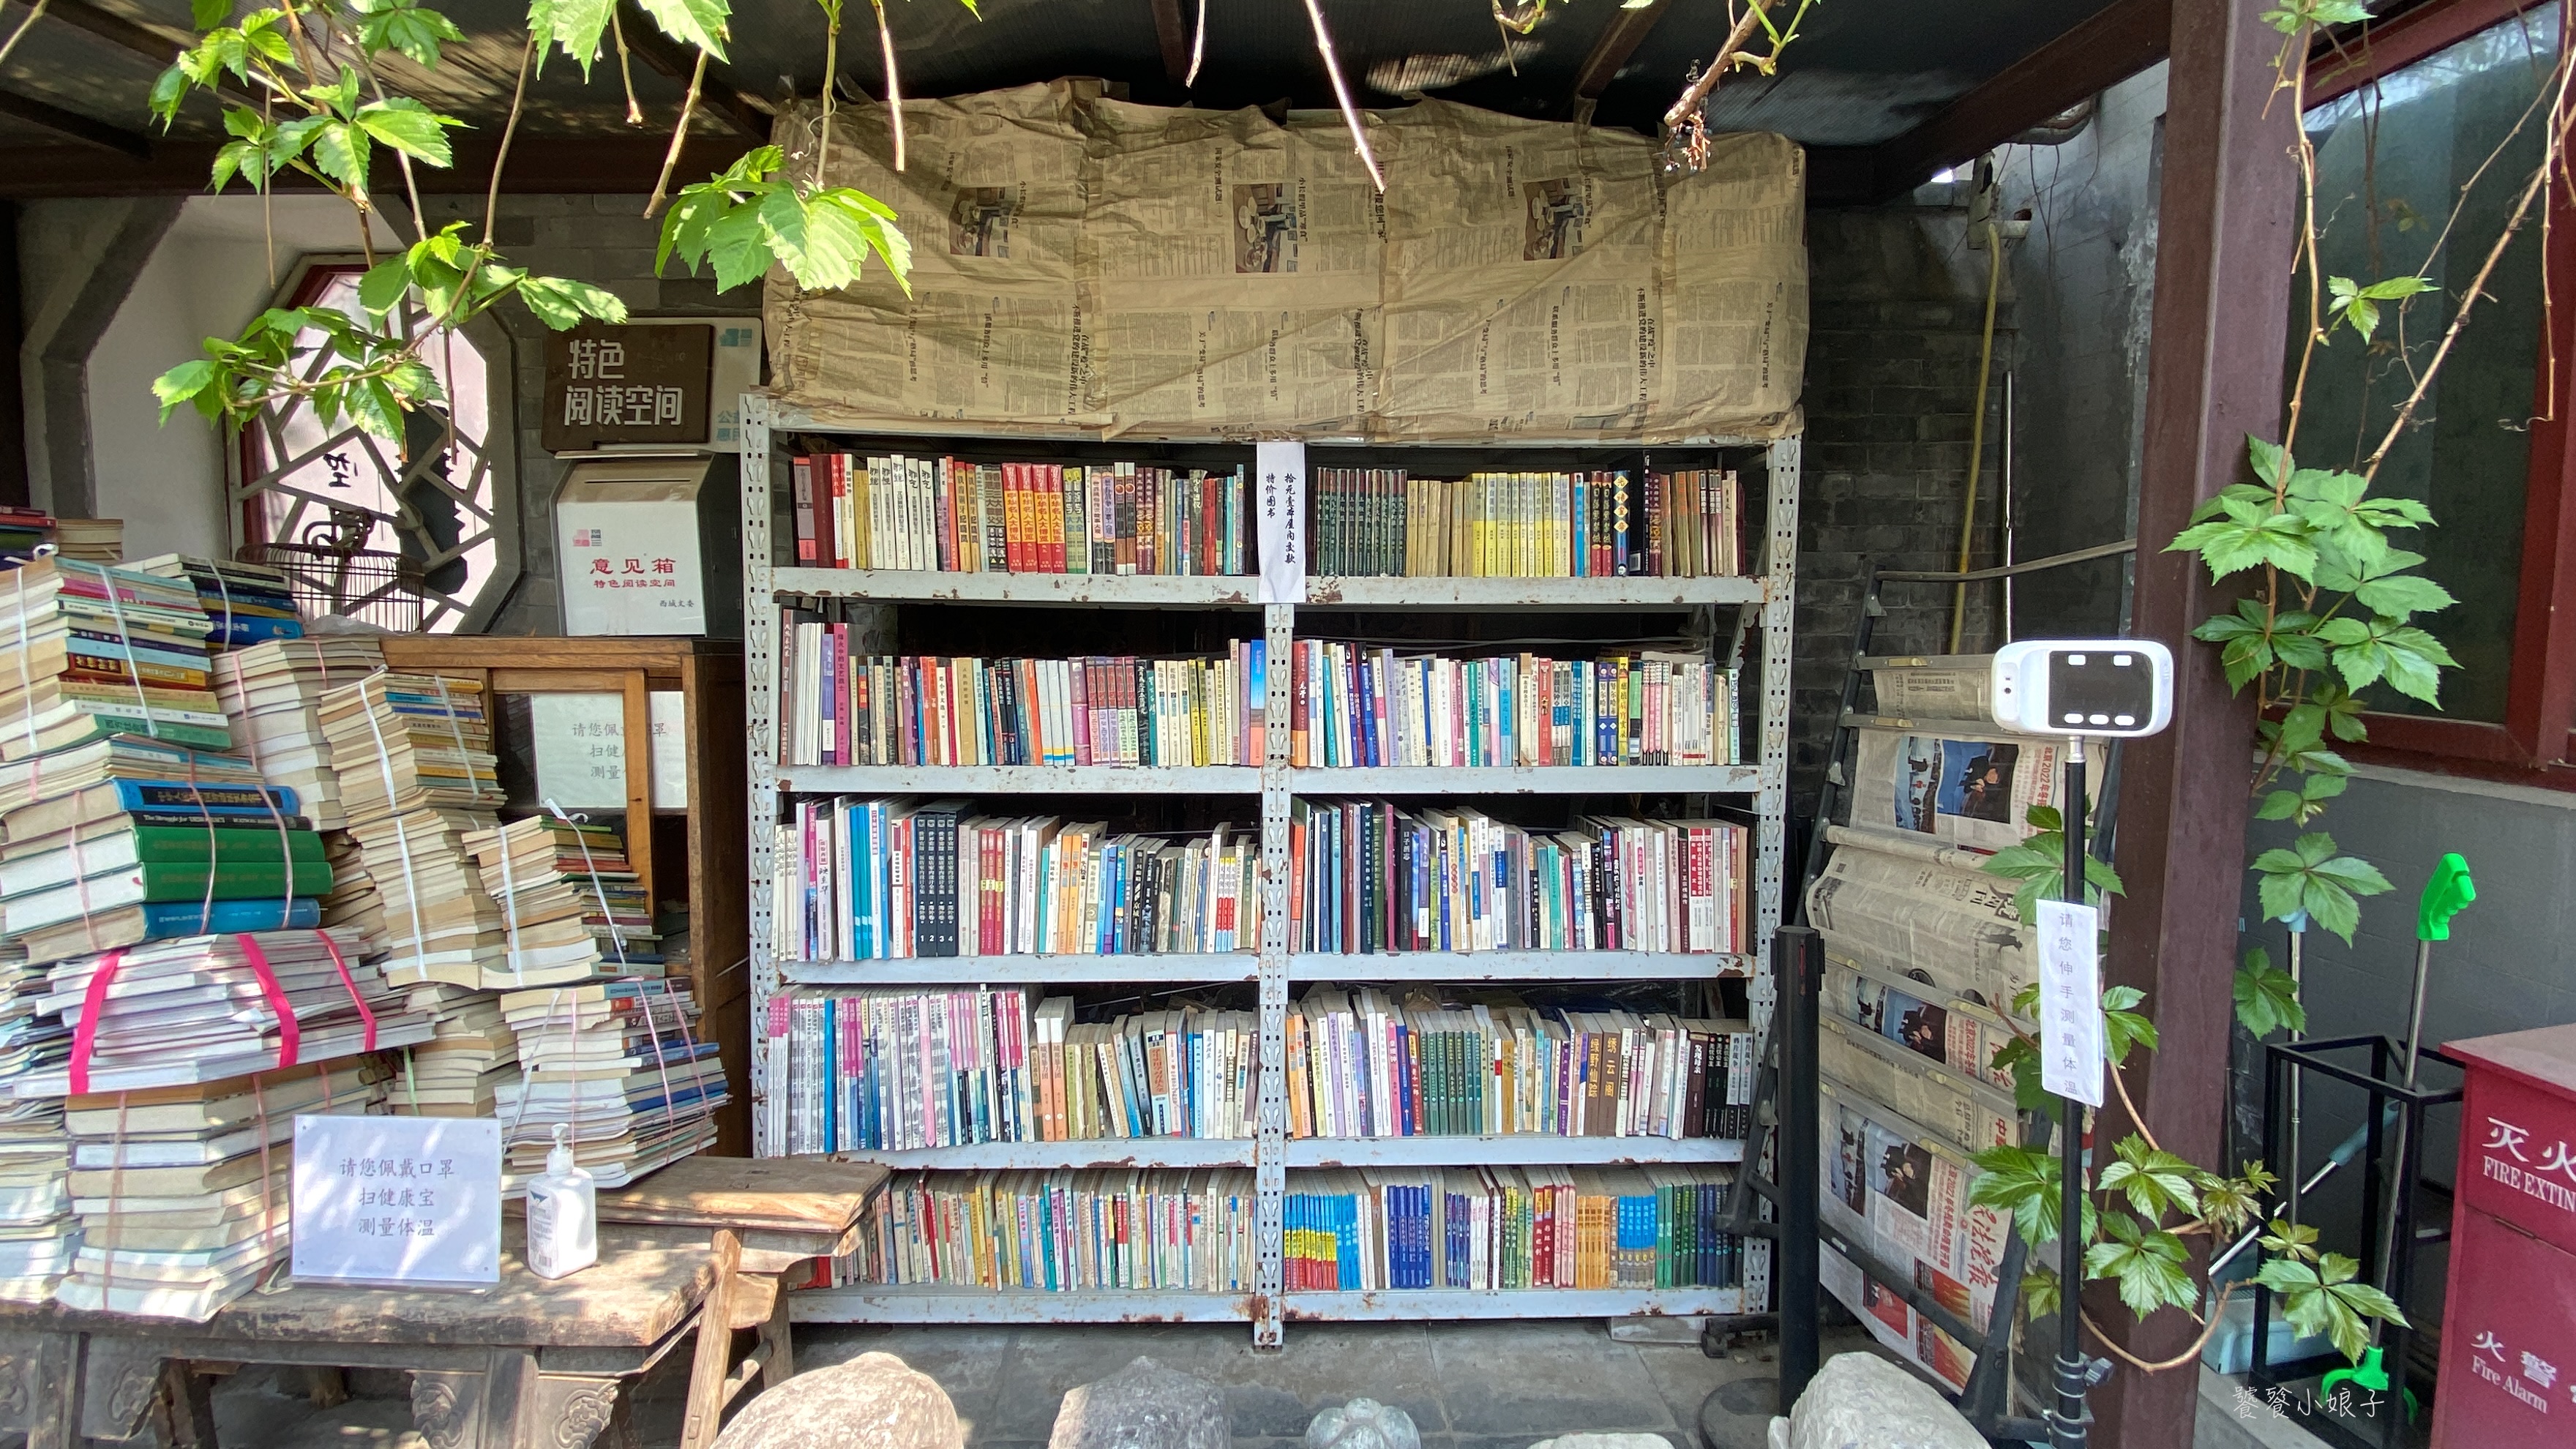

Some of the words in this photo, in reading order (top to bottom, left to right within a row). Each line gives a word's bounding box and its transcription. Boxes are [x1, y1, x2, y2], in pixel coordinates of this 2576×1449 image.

[568, 339, 626, 379] 特色
[564, 385, 684, 426] 阅读空间
[1265, 473, 1278, 519] 特价图书
[590, 558, 677, 574] 意见箱
[594, 579, 676, 588] 特色阅读空间
[659, 599, 695, 608] 西城文委
[939, 675, 947, 711] 邓小平文选
[573, 723, 667, 737] 请您佩罩
[590, 744, 625, 758] 扫健
[590, 765, 626, 779] 测量
[1573, 872, 1584, 925] 北京女人
[920, 935, 925, 943] 1
[929, 935, 935, 943] 2
[939, 935, 945, 943] 3
[948, 935, 954, 943] 4
[2058, 913, 2078, 1096] 请您伸手测量体温
[1588, 1038, 1600, 1098] 绿野仙踪
[1604, 1037, 1617, 1098] 绣云阁
[2482, 1116, 2576, 1184] 灭火
[339, 1158, 455, 1179] 请您佩戴口罩
[2483, 1155, 2521, 1192] FIRE
[359, 1188, 435, 1208] 扫健康宝
[357, 1218, 435, 1238] 测量体温
[2471, 1330, 2558, 1390] 火警
[2472, 1354, 2501, 1387] Fire
[2502, 1375, 2549, 1415] Alarm
